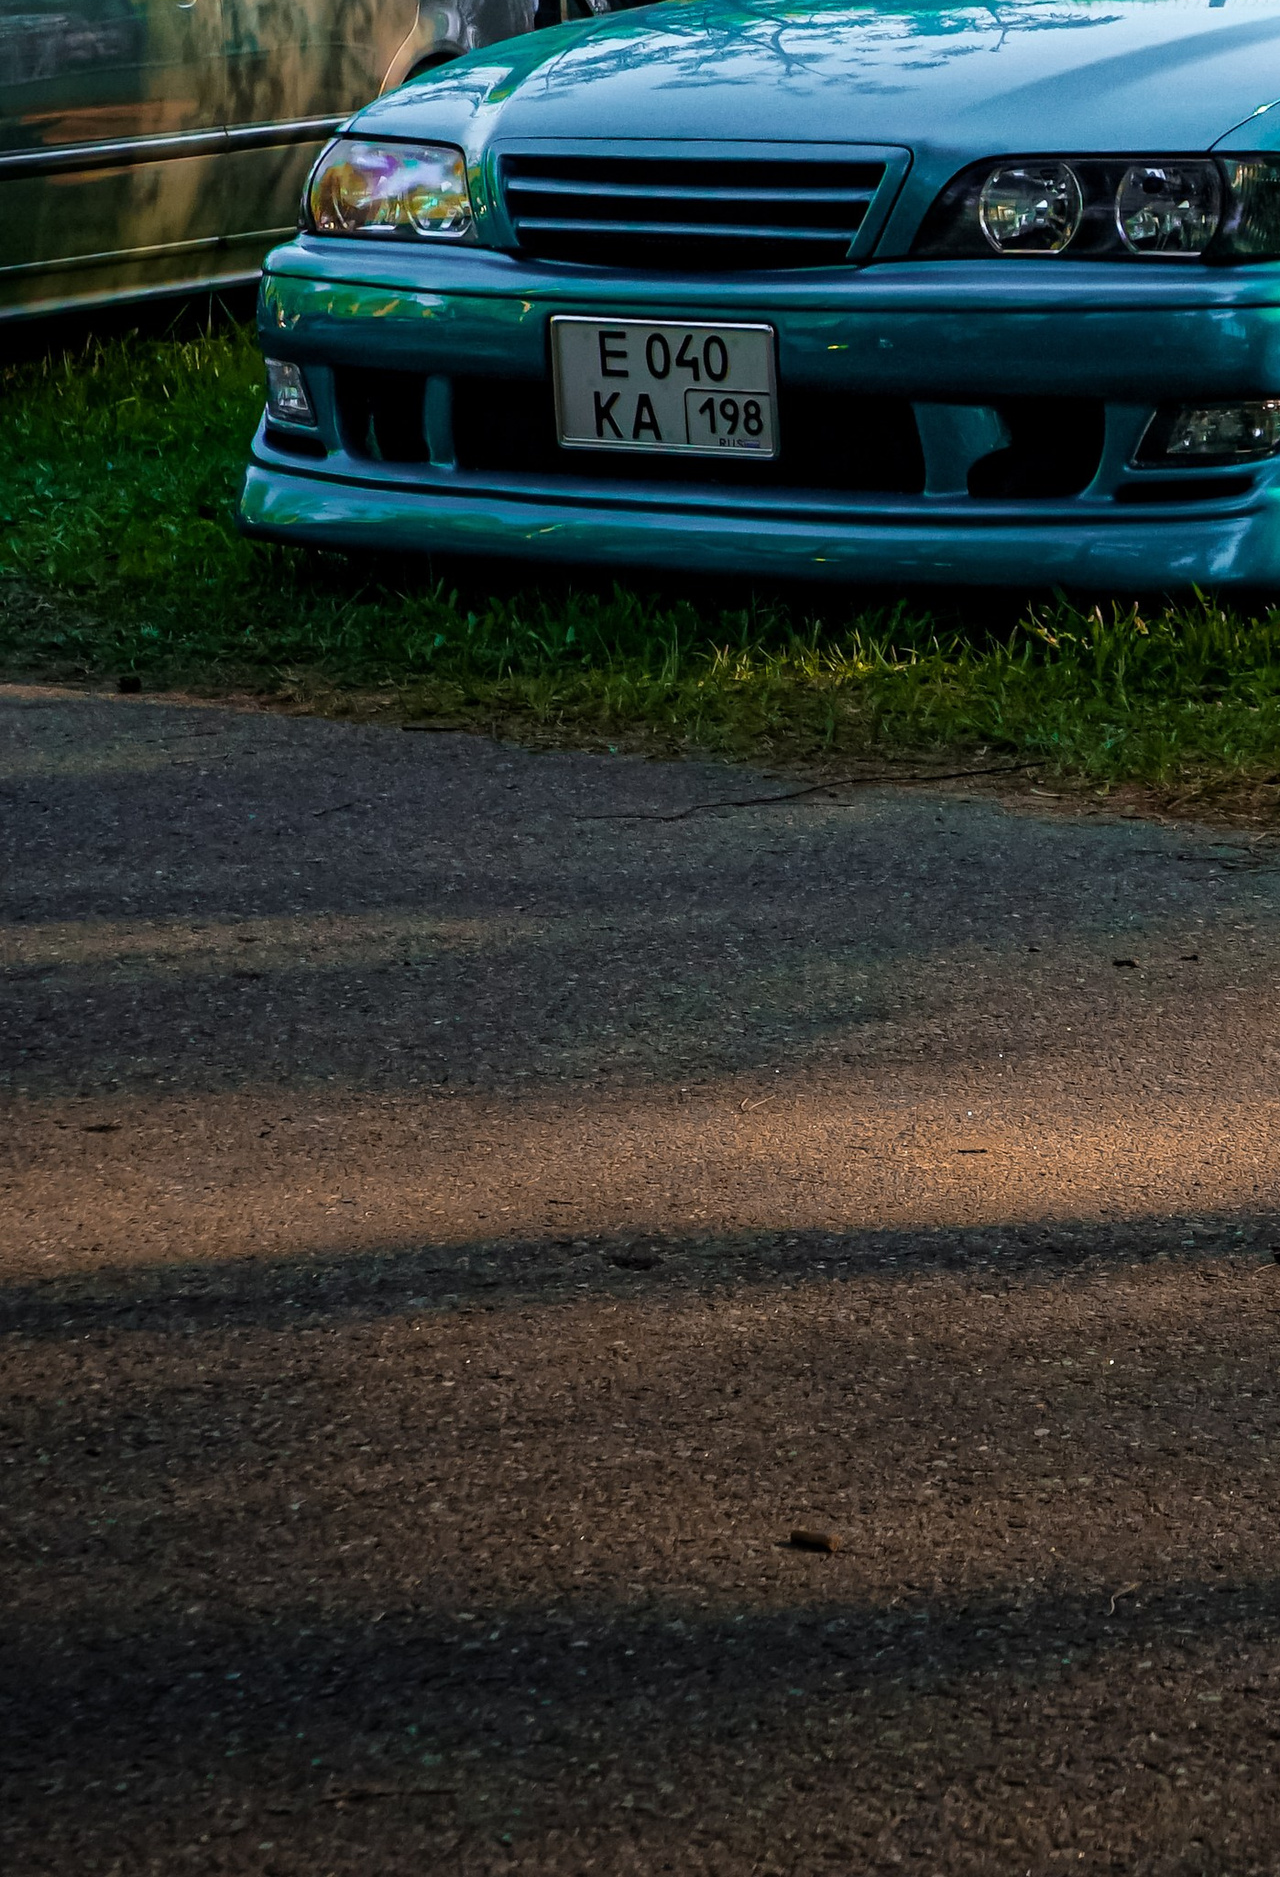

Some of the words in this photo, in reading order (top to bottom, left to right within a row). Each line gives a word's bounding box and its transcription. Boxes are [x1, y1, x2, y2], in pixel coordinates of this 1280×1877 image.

[599, 330, 629, 378] E
[646, 333, 728, 382] 040
[594, 391, 662, 440] KA
[699, 397, 764, 436] 198
